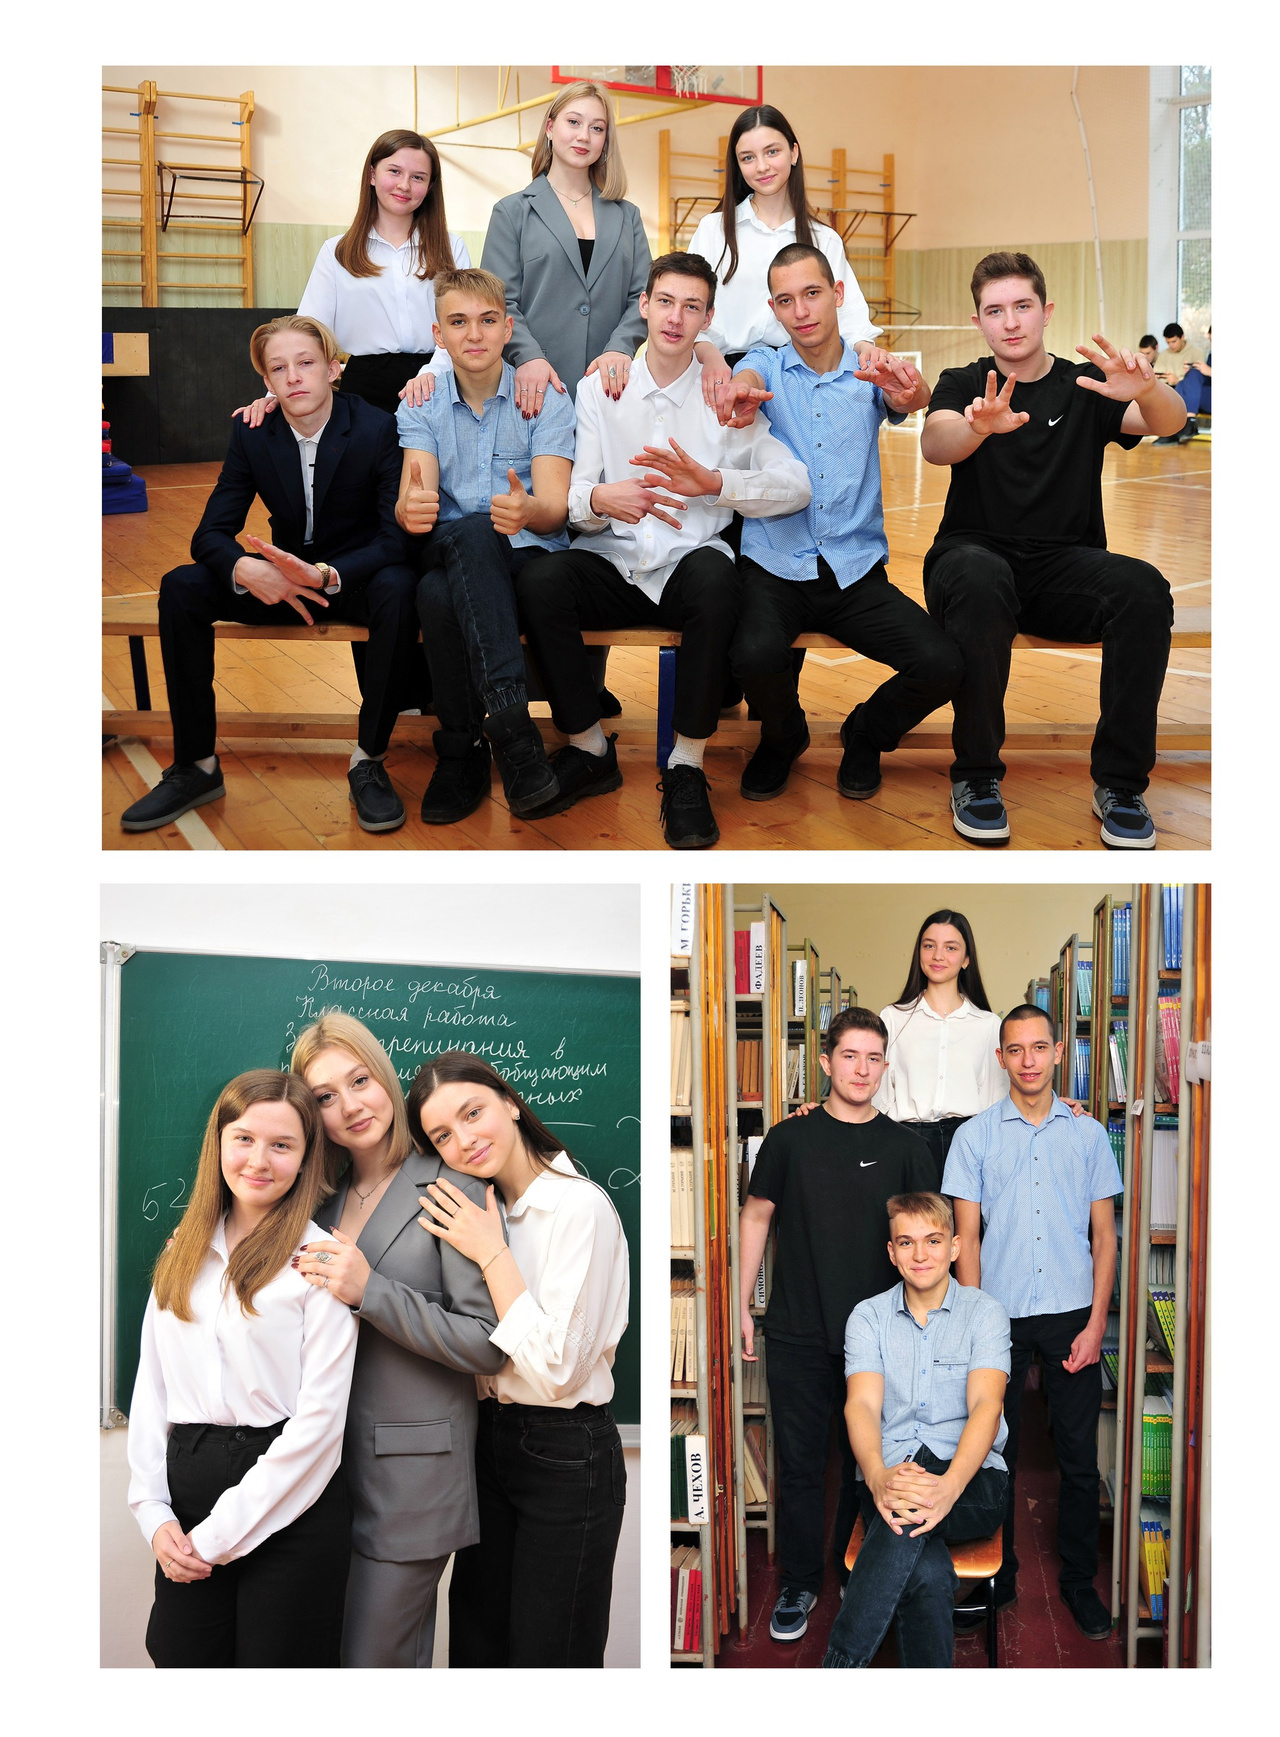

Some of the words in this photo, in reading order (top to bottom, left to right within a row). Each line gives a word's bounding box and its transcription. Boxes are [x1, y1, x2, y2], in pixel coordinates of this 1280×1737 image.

[754, 944, 763, 990] ФАДЕЕВ
[308, 963, 395, 1000] Второе
[407, 975, 502, 1010] декабря
[423, 1005, 517, 1029] работа
[551, 1037, 567, 1060] в
[490, 1061, 607, 1087] бобщающим
[757, 1260, 766, 1304] СИМОНО
[691, 1451, 704, 1499] ЧЕХОВ
[693, 1505, 705, 1520] А.
